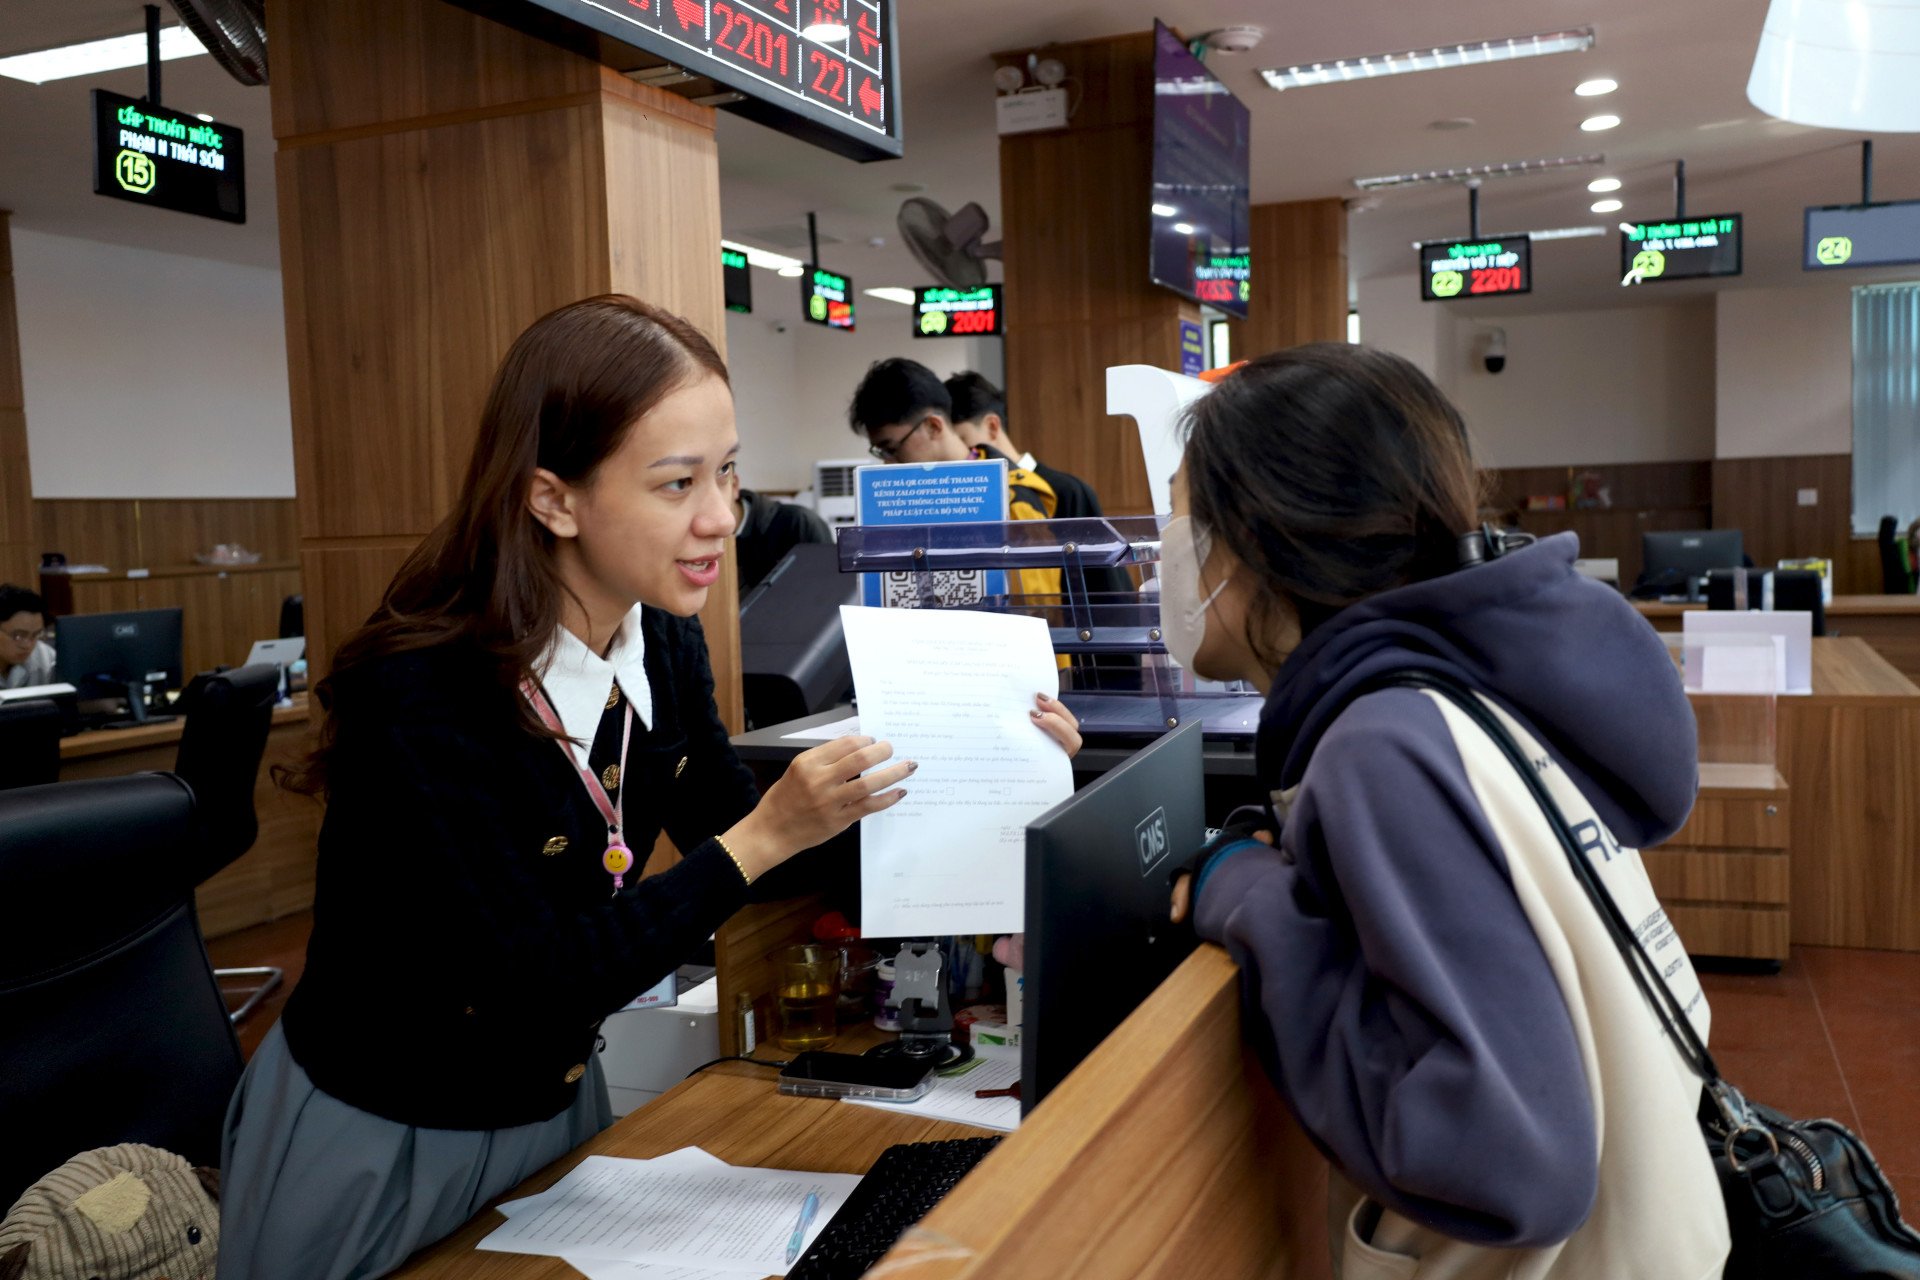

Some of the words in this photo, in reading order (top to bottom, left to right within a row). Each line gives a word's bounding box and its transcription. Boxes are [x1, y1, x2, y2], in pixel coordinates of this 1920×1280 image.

[713, 2, 788, 76] 2201
[810, 51, 845, 102] 22
[120, 129, 156, 154] PHẠM
[158, 139, 168, 157] N
[170, 142, 198, 164] THÁI
[199, 148, 225, 171] SƠN
[122, 156, 149, 185] 15
[1470, 266, 1521, 293] 2201
[952, 310, 995, 333] 2001
[872, 478, 891, 489] QUÉT
[906, 479, 917, 487] QR
[917, 478, 938, 486] CODE
[974, 475, 989, 483] GIA
[874, 488, 895, 498] KÊNH
[895, 488, 916, 497] ZALO
[916, 487, 950, 496] OFFICIAL
[952, 486, 988, 494] ACCOUNT
[883, 507, 903, 517] PHÁP
[1140, 818, 1165, 864] CMS
